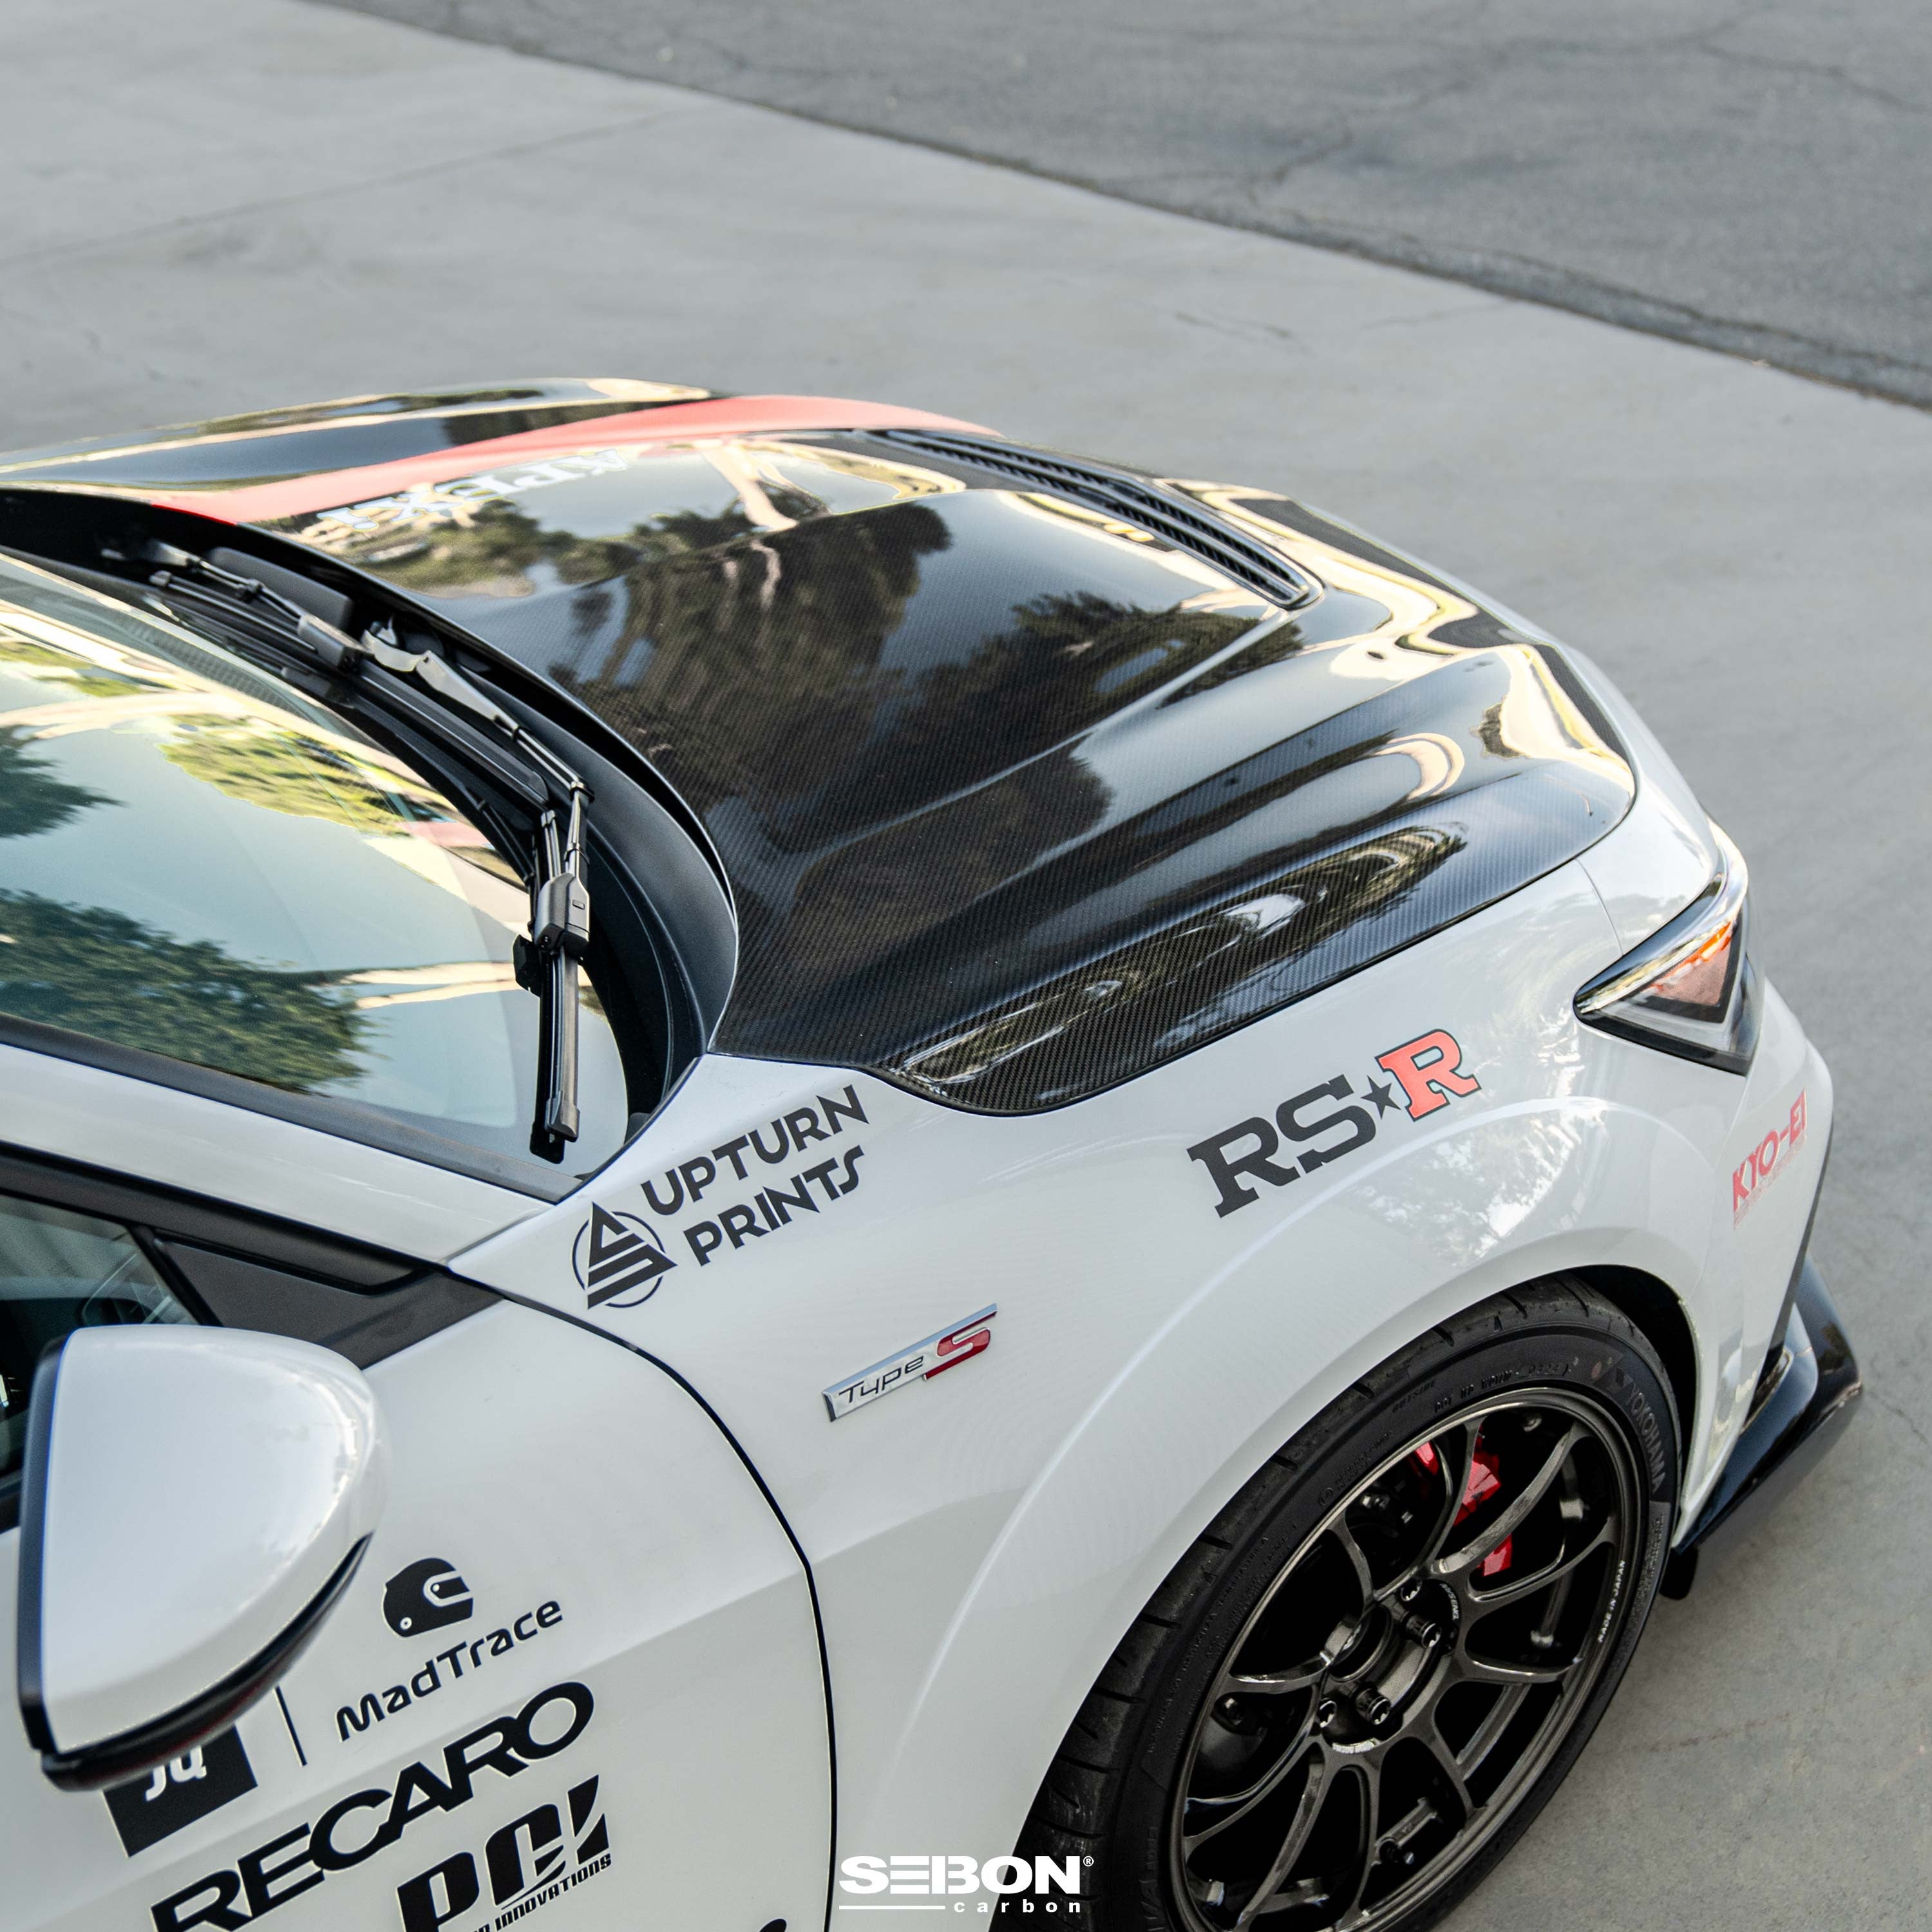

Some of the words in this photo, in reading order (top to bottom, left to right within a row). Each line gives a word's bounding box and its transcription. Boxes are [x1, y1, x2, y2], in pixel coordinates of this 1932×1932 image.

[640, 1084, 869, 1216] UPTURN
[683, 1144, 865, 1266] PRINTS
[1732, 1087, 1807, 1213] KYO-EI
[838, 1355, 924, 1403] Type
[1626, 1383, 1667, 1495] YOKOHAMA
[1597, 1612, 1613, 1643] MADE
[1613, 1560, 1626, 1597] JAPAN
[336, 1600, 563, 1741] MadTrace
[151, 1681, 594, 1932] RECARO
